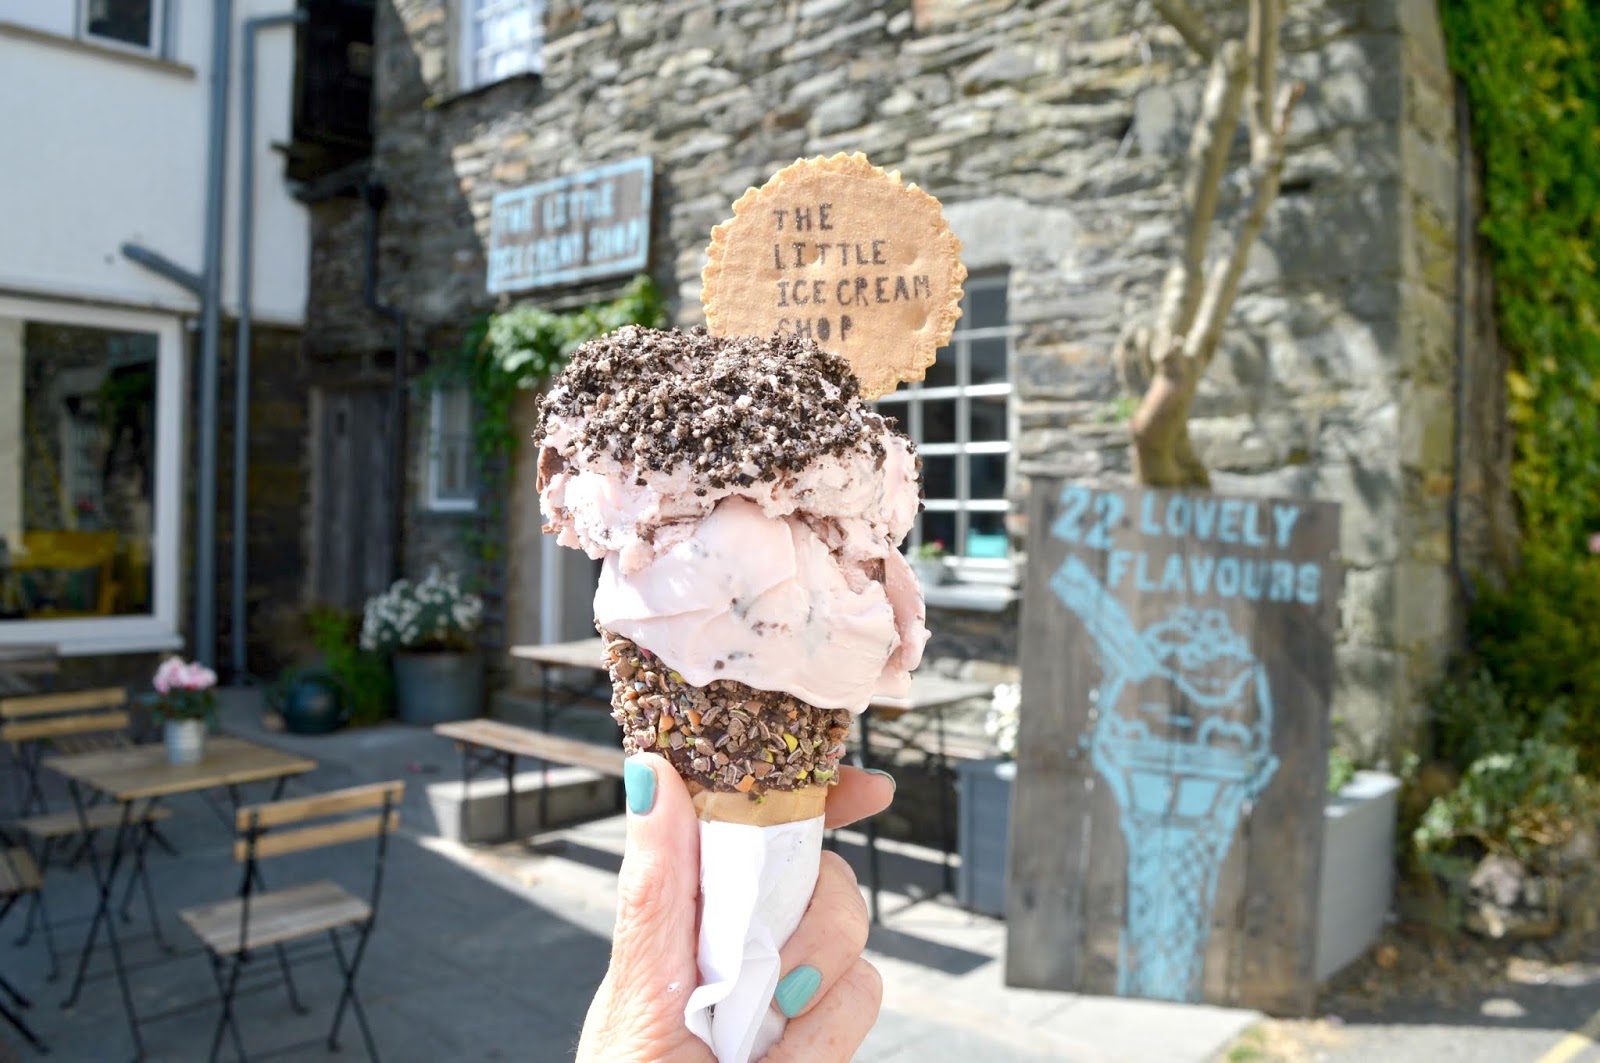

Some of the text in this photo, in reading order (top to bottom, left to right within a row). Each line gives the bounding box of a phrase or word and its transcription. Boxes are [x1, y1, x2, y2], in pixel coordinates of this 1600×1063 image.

[542, 181, 614, 229] LITTLE
[773, 203, 833, 231] THE
[774, 240, 886, 270] LITTLE
[777, 275, 932, 307] ICE CREAM
[777, 314, 853, 341] SHOP
[1049, 484, 1300, 549] 22 LOVELY
[1108, 549, 1321, 604] FLAVOURS
